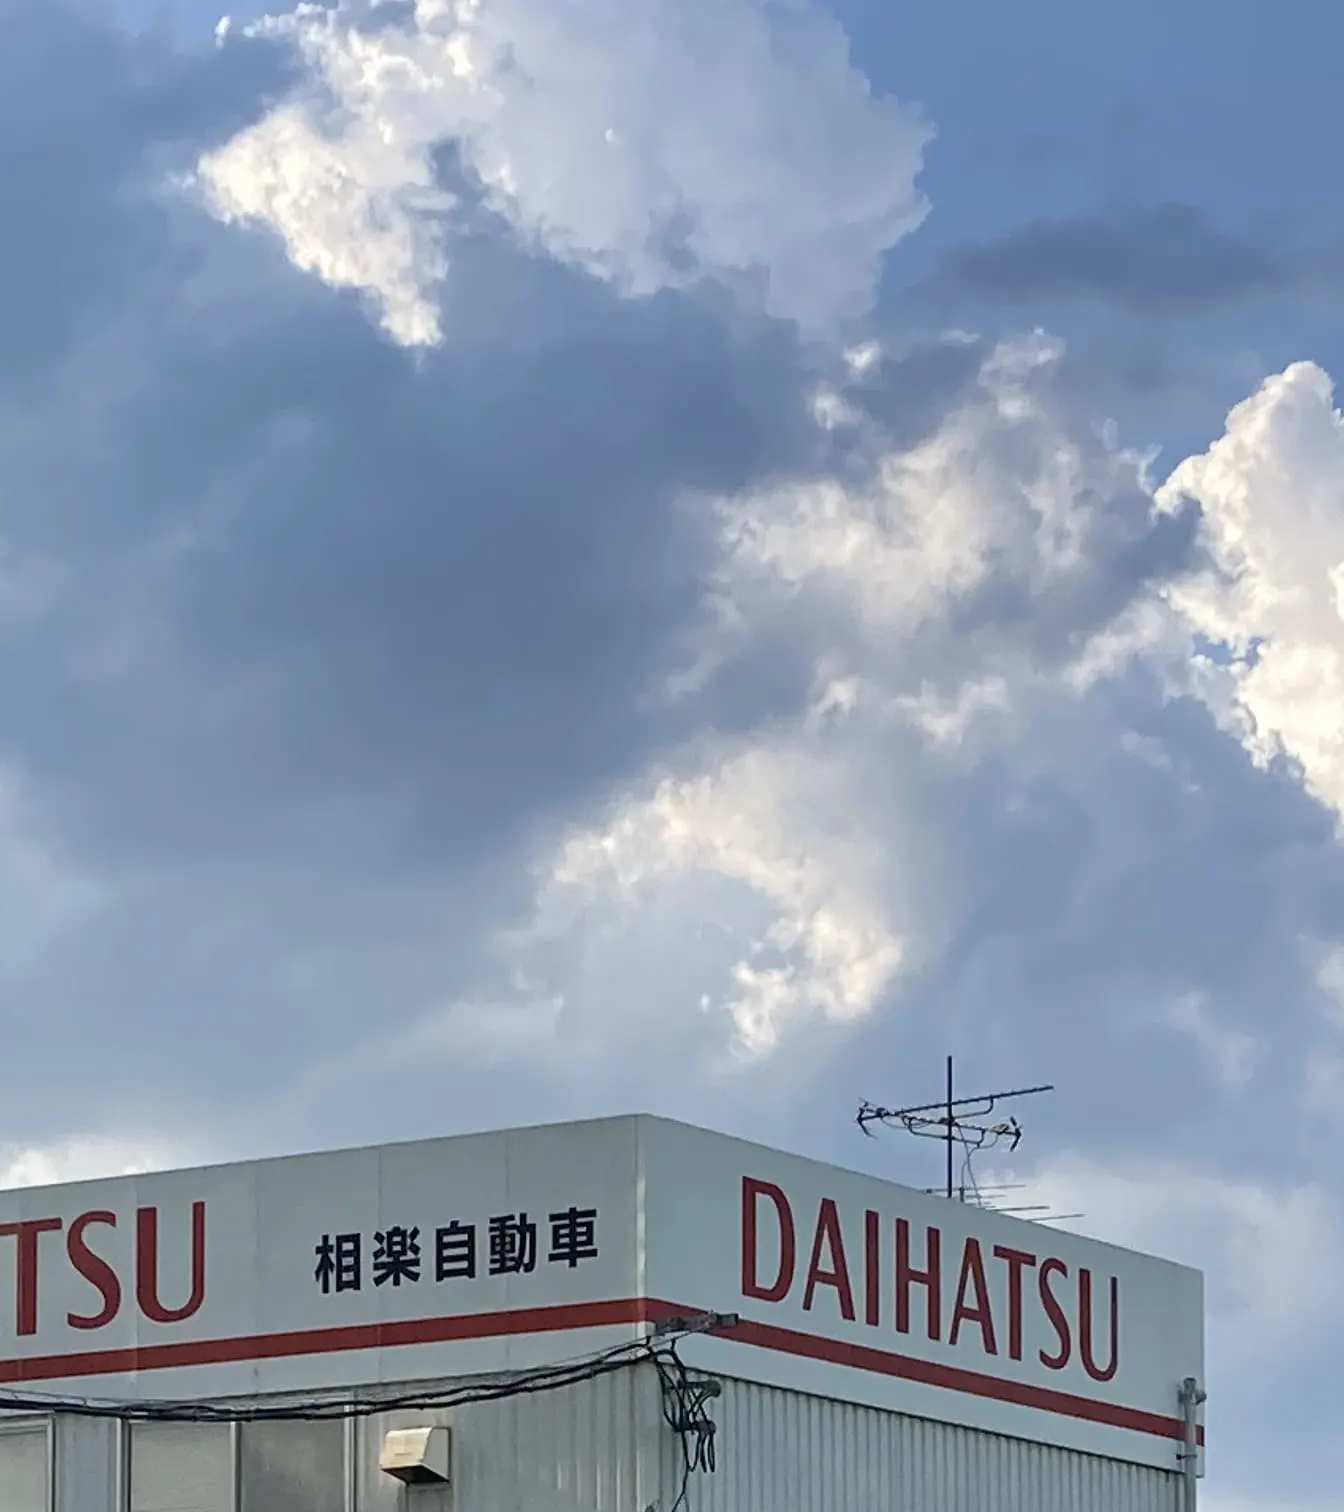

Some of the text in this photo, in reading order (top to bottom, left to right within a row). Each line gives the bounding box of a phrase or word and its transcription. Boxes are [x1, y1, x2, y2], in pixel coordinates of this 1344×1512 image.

[314, 1207, 599, 1296] 相楽自動車
[741, 1175, 1119, 1383] DAIHATSU
